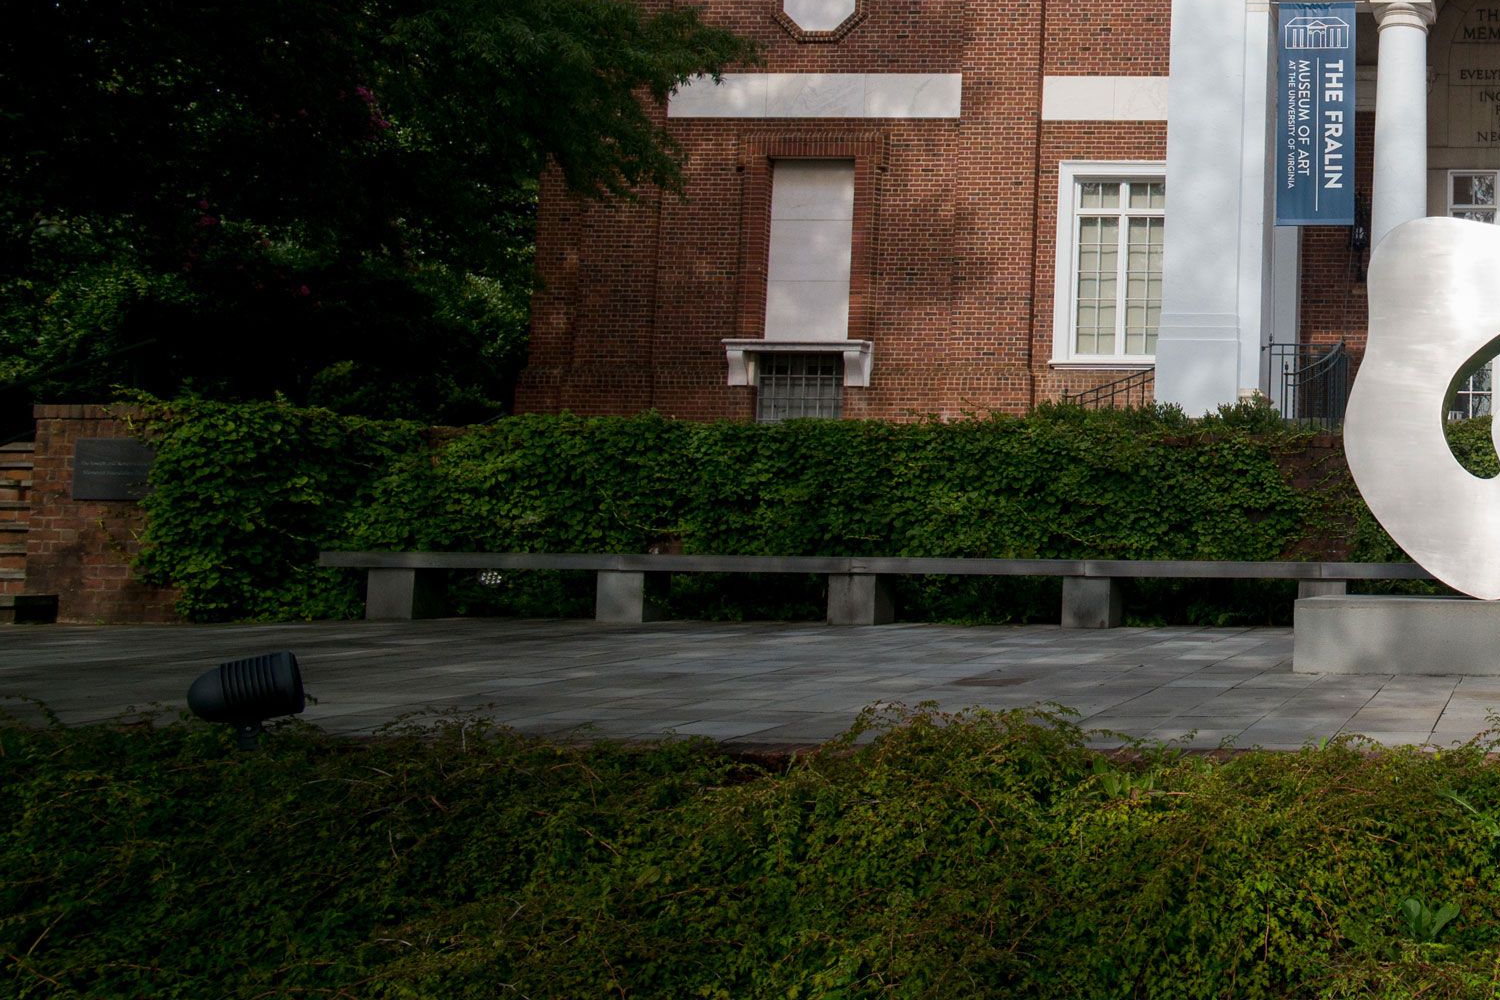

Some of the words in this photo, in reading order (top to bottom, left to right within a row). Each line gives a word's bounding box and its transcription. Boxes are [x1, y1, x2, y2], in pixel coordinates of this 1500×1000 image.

[1288, 72, 1296, 88] THE
[1289, 60, 1296, 70] AT
[1325, 59, 1344, 102] THE
[1298, 60, 1311, 120] MUSEUM
[1288, 90, 1296, 138] UNIVERSITY
[1288, 139, 1295, 150] OF
[1298, 125, 1310, 146] OF
[1324, 110, 1343, 189] FRALIN
[1287, 153, 1295, 189] VIRGINIA
[1298, 149, 1310, 176] ART
